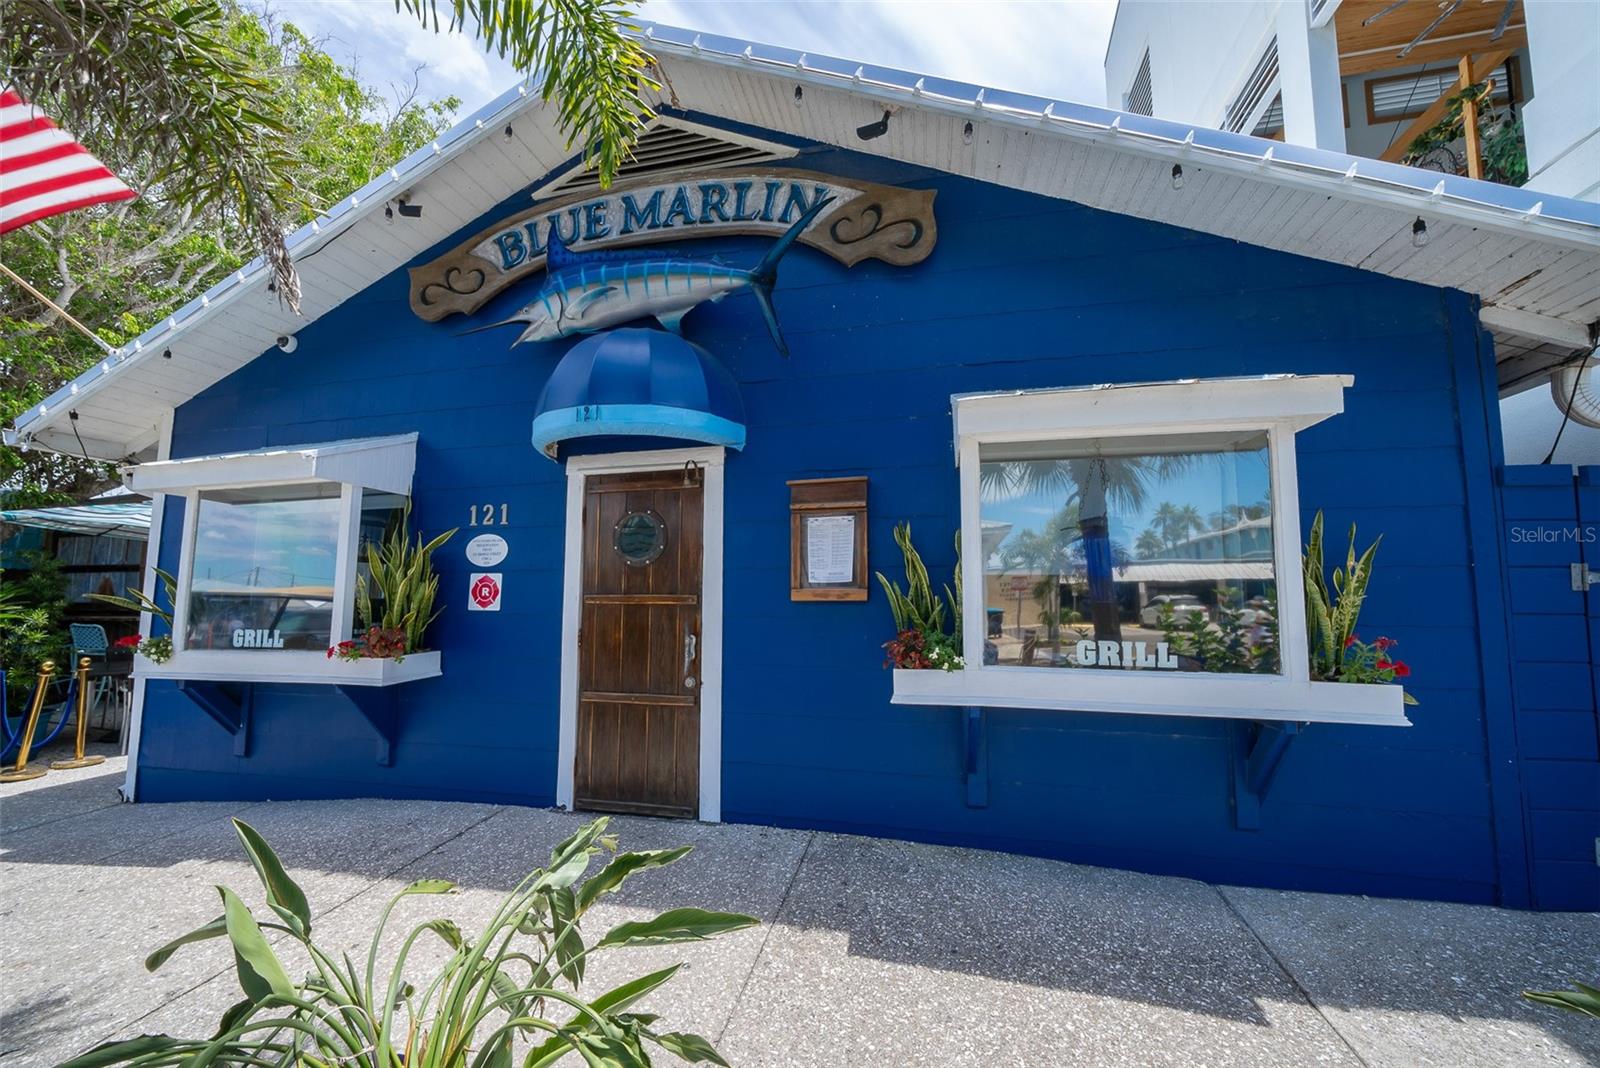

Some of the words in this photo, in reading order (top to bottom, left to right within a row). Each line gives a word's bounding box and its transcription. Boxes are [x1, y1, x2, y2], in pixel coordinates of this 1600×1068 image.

[493, 199, 611, 270] BLUE
[619, 181, 832, 235] MARLIN
[469, 503, 509, 527] 121
[481, 587, 490, 597] R
[232, 628, 284, 649] GRILL
[1075, 639, 1179, 669] GRILL
